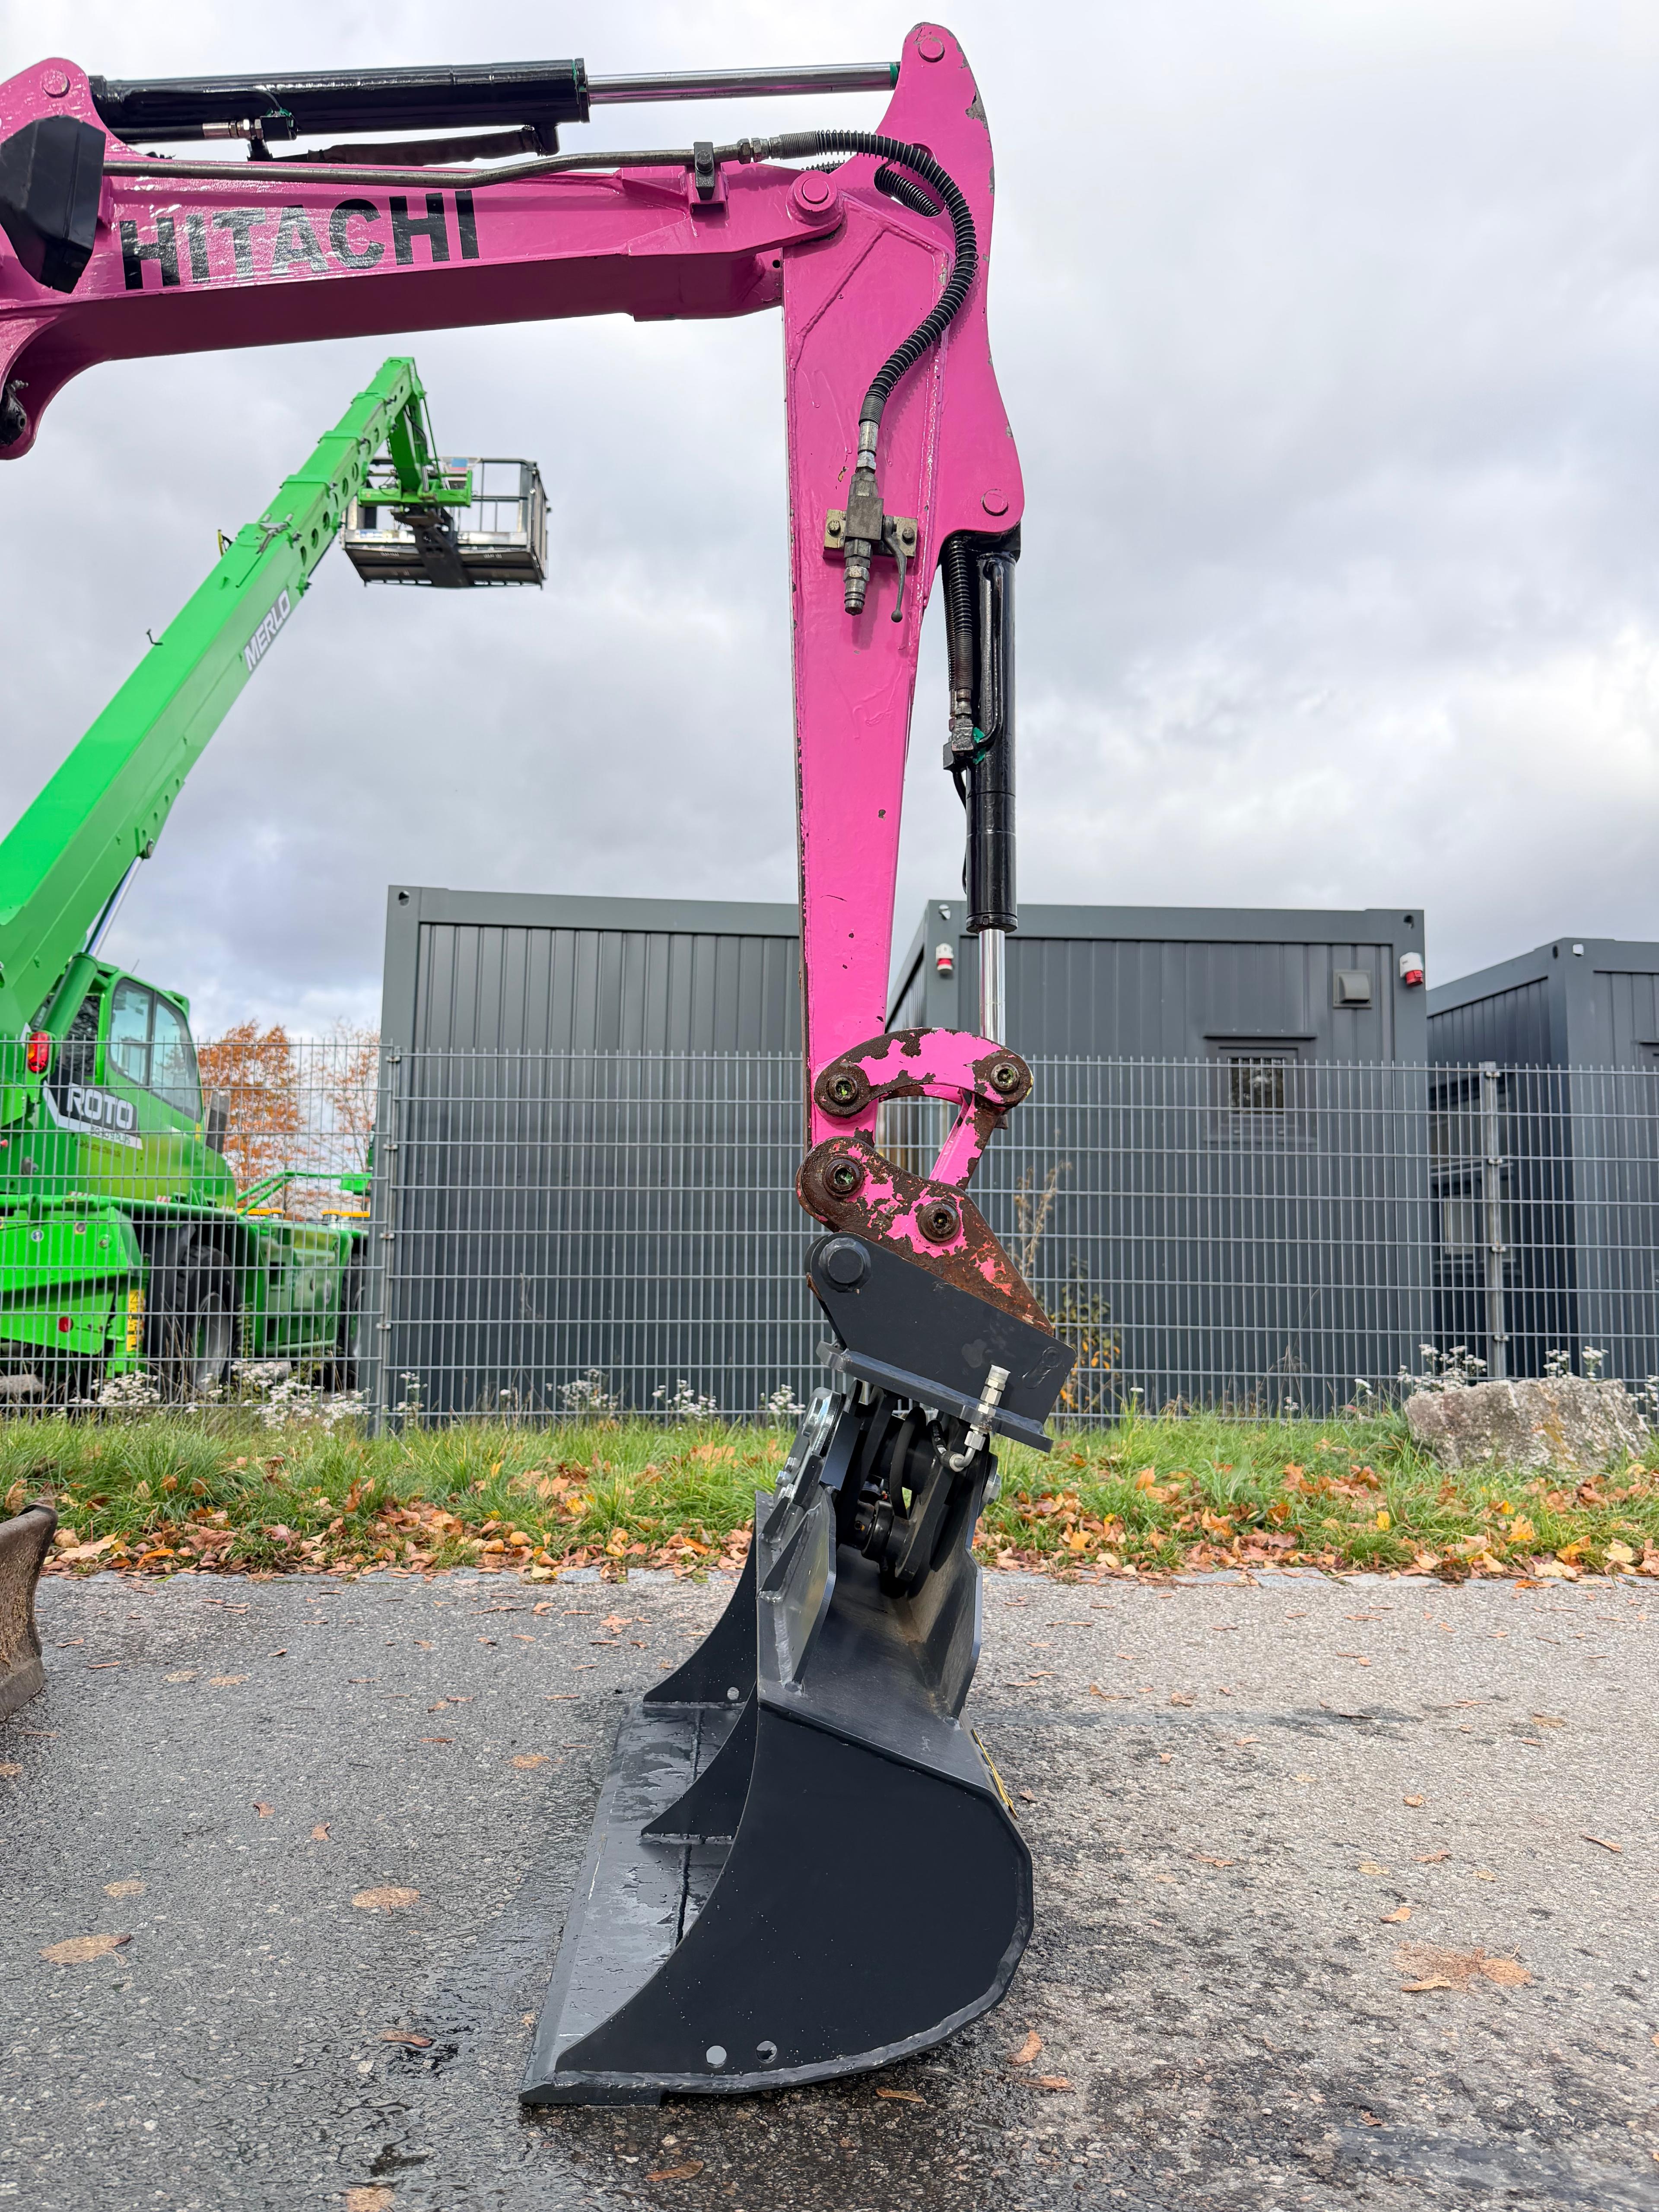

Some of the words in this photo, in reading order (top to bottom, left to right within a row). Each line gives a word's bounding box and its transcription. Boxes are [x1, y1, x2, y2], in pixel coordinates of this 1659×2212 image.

[120, 191, 480, 290] HITACHI
[243, 589, 290, 671] MERLO
[67, 1083, 133, 1130] ROTO
